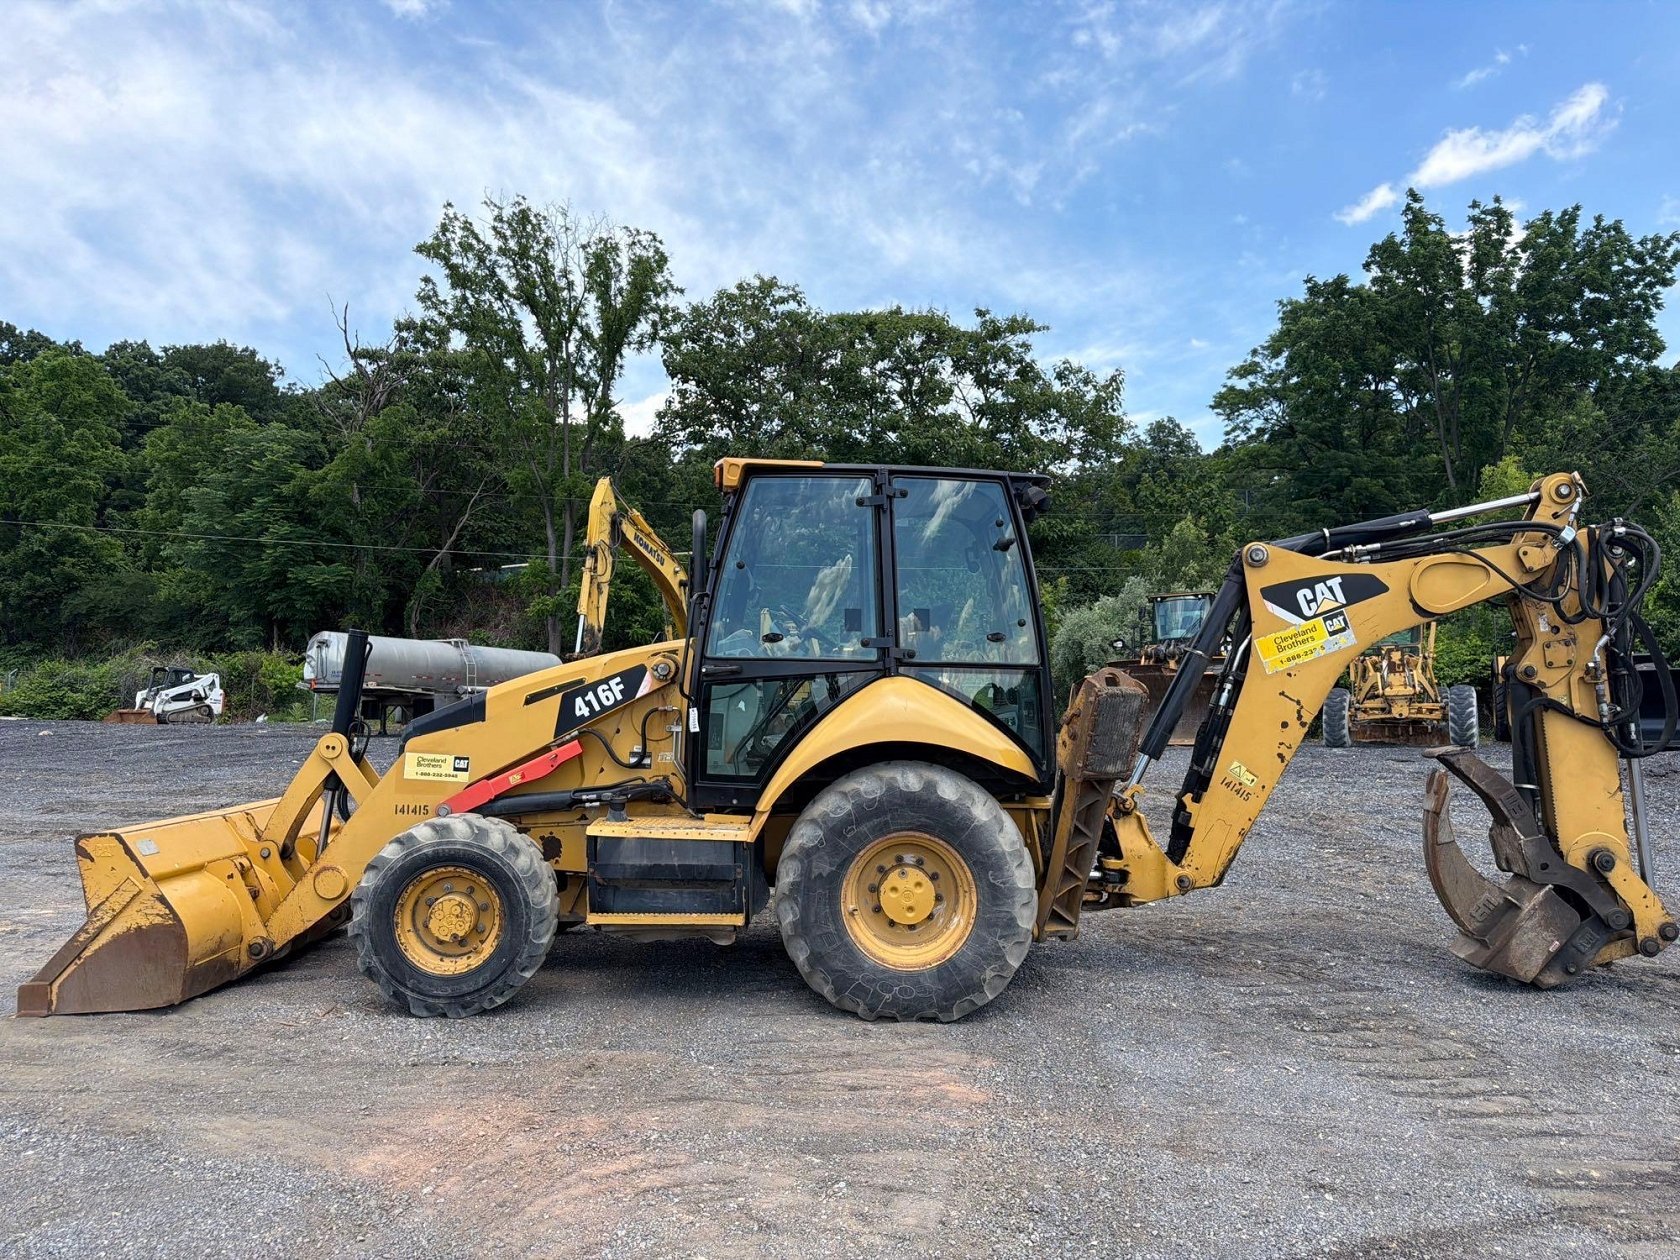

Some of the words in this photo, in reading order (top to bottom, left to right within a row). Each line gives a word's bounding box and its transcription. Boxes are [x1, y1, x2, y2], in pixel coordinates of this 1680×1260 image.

[634, 532, 665, 567] KOMATSU
[1296, 576, 1347, 617] CAT
[1325, 615, 1345, 632] CAT
[1273, 624, 1318, 645] Cleveland
[1276, 635, 1316, 654] Brothers
[574, 676, 625, 718] 416F
[416, 756, 447, 764] Cleveland
[416, 761, 442, 769] Brothers
[454, 759, 469, 769] CAT
[1220, 776, 1252, 801] 141415
[394, 804, 429, 816] 141415
